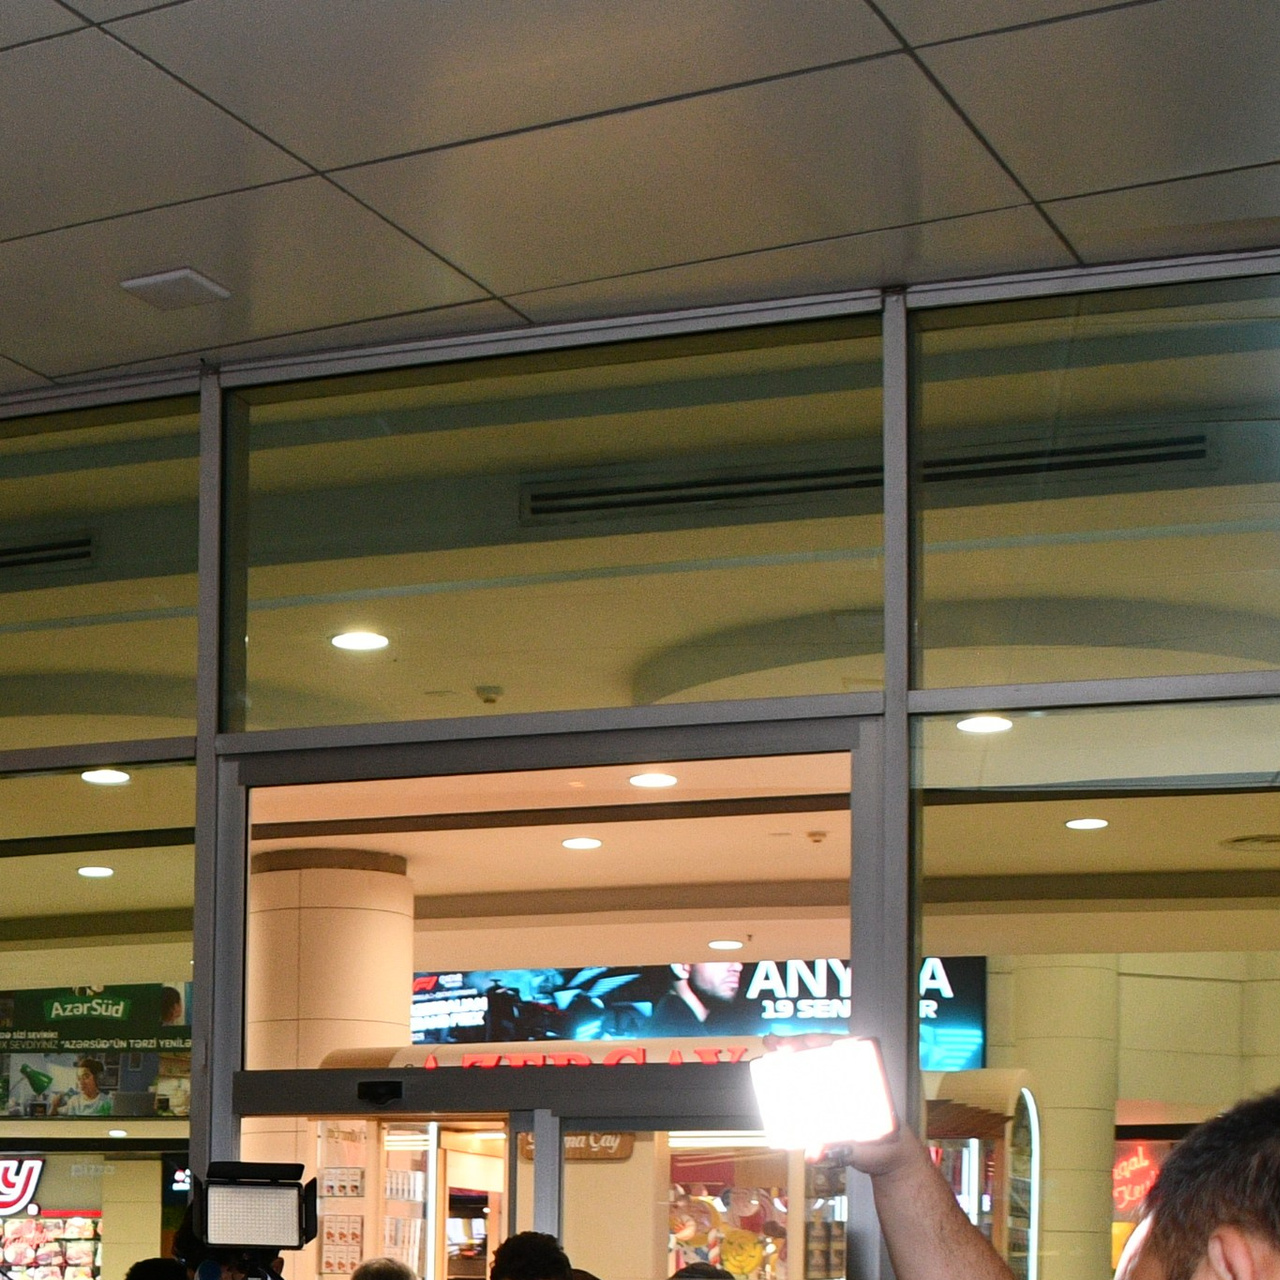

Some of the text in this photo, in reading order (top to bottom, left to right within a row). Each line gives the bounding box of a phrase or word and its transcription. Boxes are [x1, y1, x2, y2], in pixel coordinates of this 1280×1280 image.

[746, 957, 954, 999] ANYA
[50, 998, 125, 1018] AzərSüd
[761, 999, 794, 1019] 19
[159, 1037, 192, 1048] YENİLƏ
